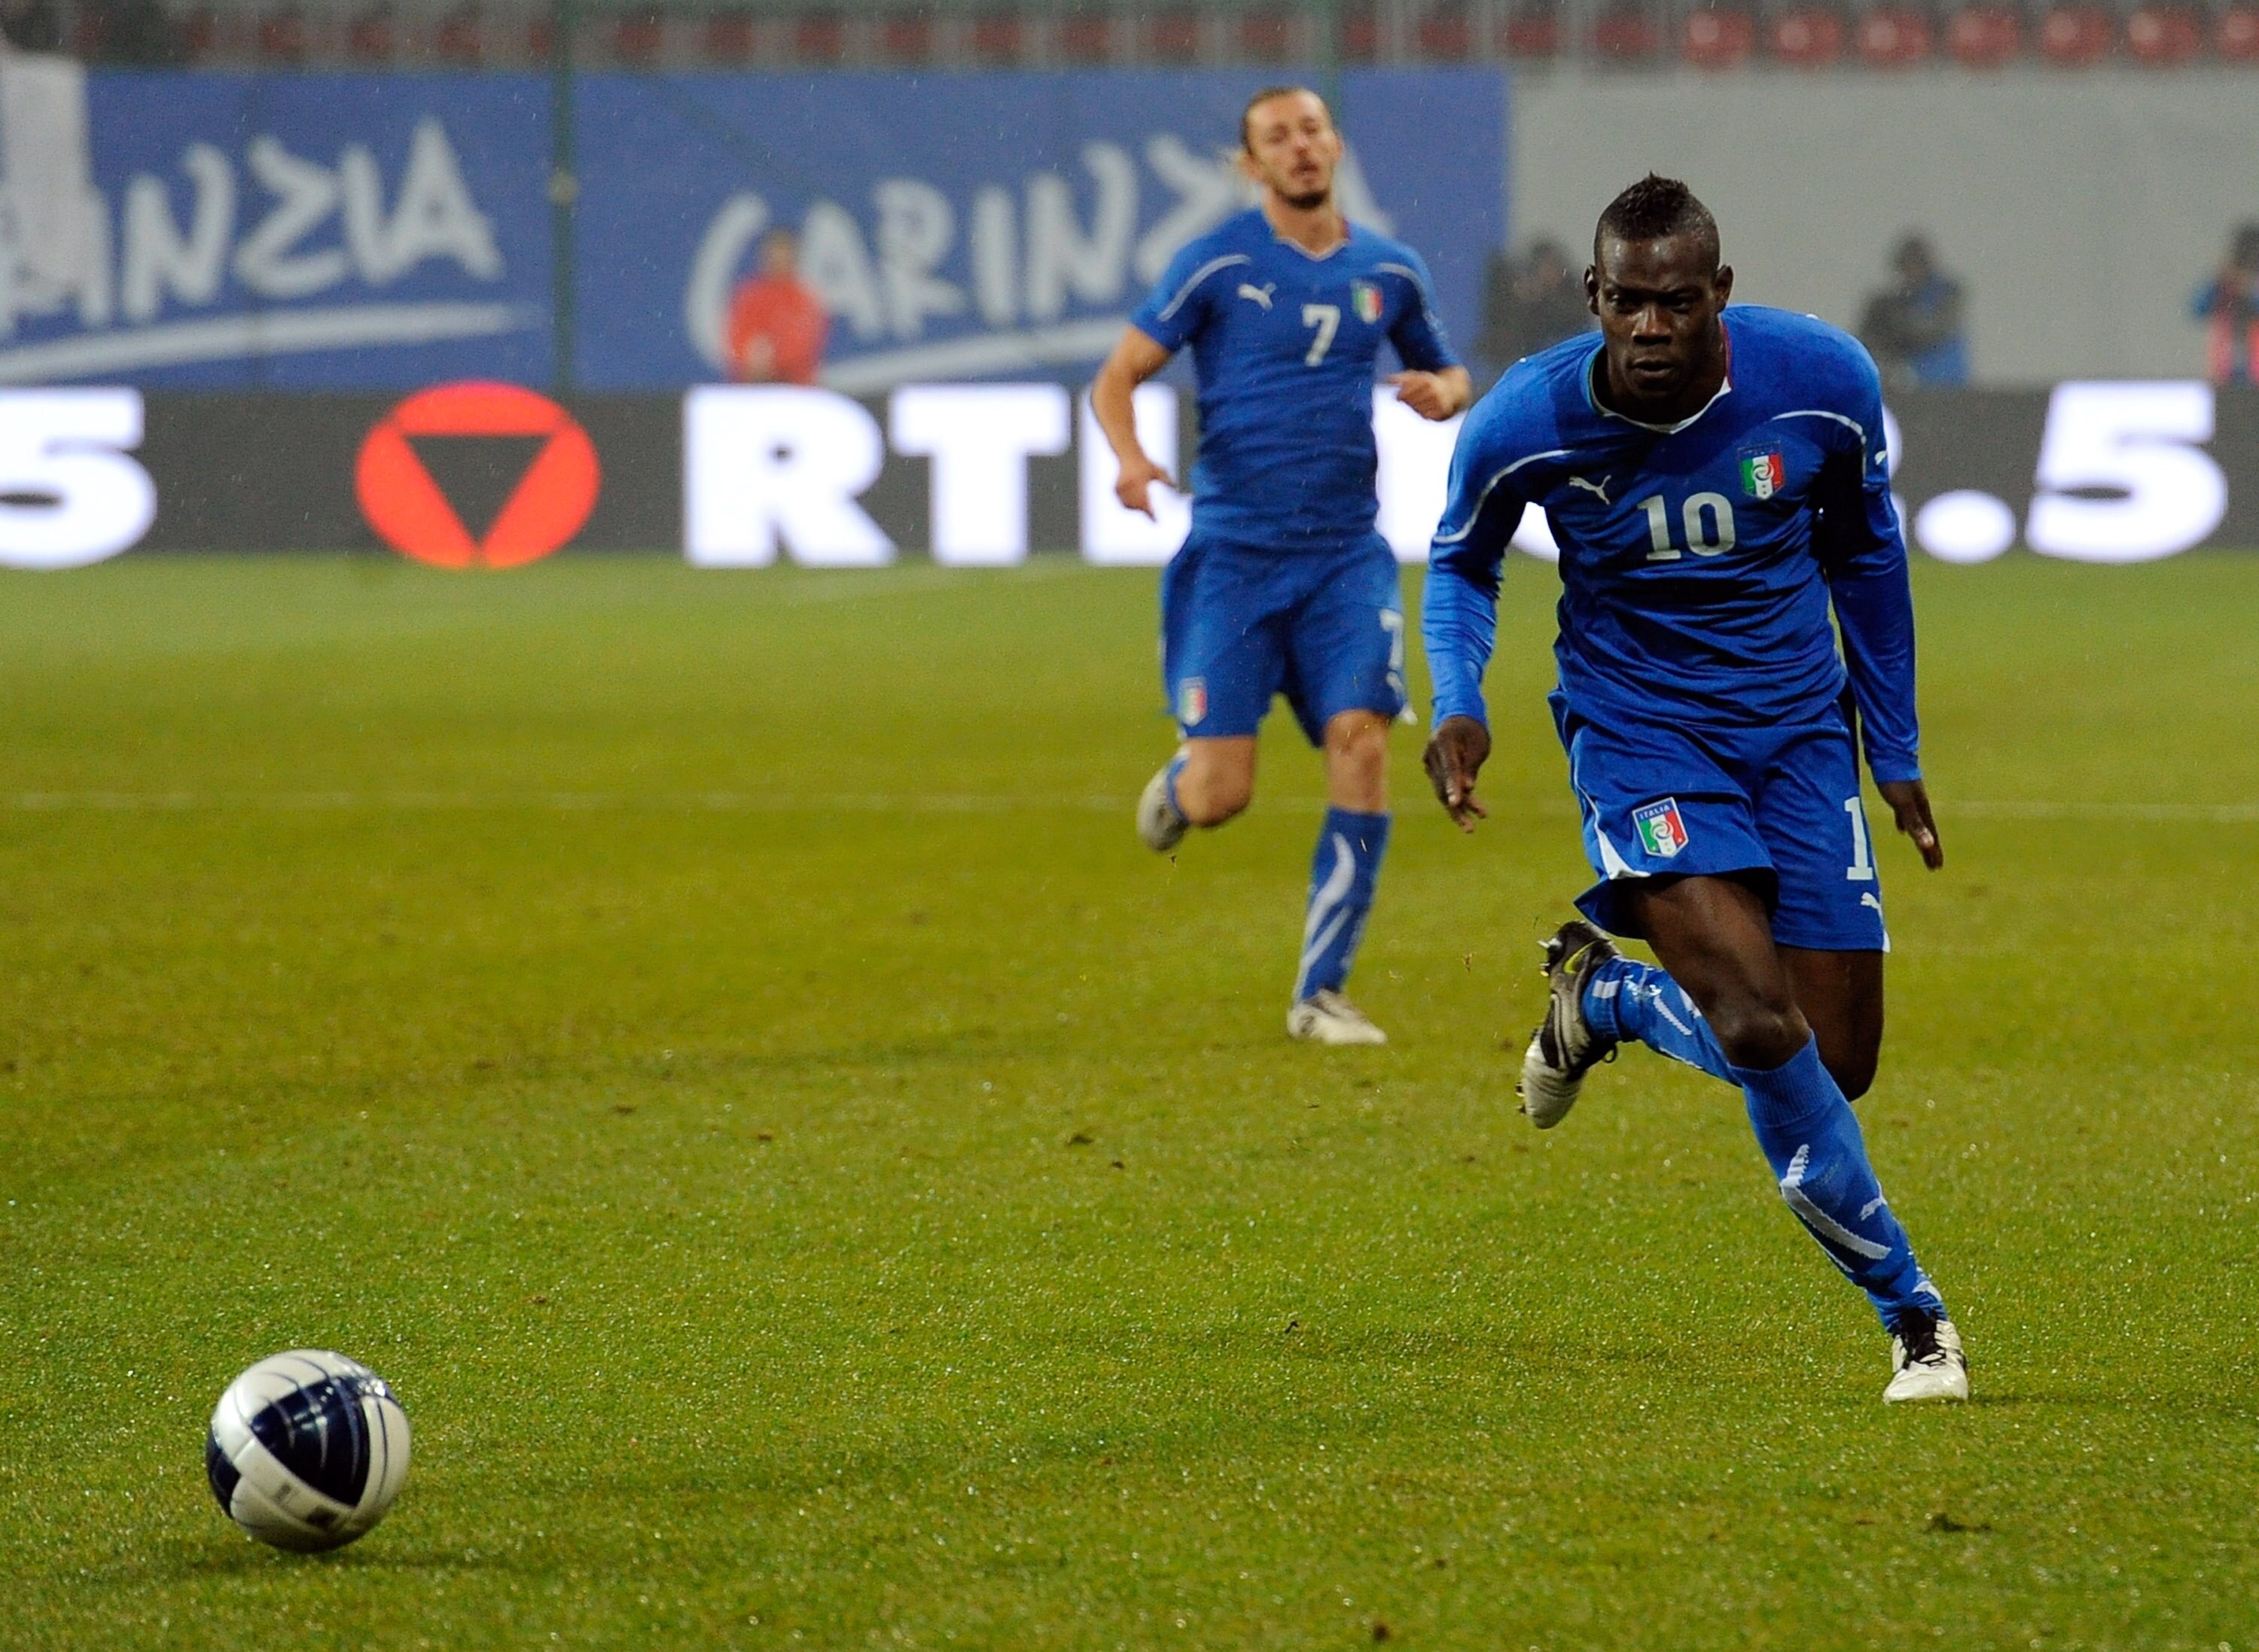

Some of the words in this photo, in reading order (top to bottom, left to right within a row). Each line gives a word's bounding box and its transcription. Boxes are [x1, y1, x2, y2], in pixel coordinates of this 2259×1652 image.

[1302, 303, 1341, 367] 7
[684, 383, 1193, 566] RTL
[1637, 492, 1736, 560] 10
[1639, 804, 1670, 820] ITALIA
